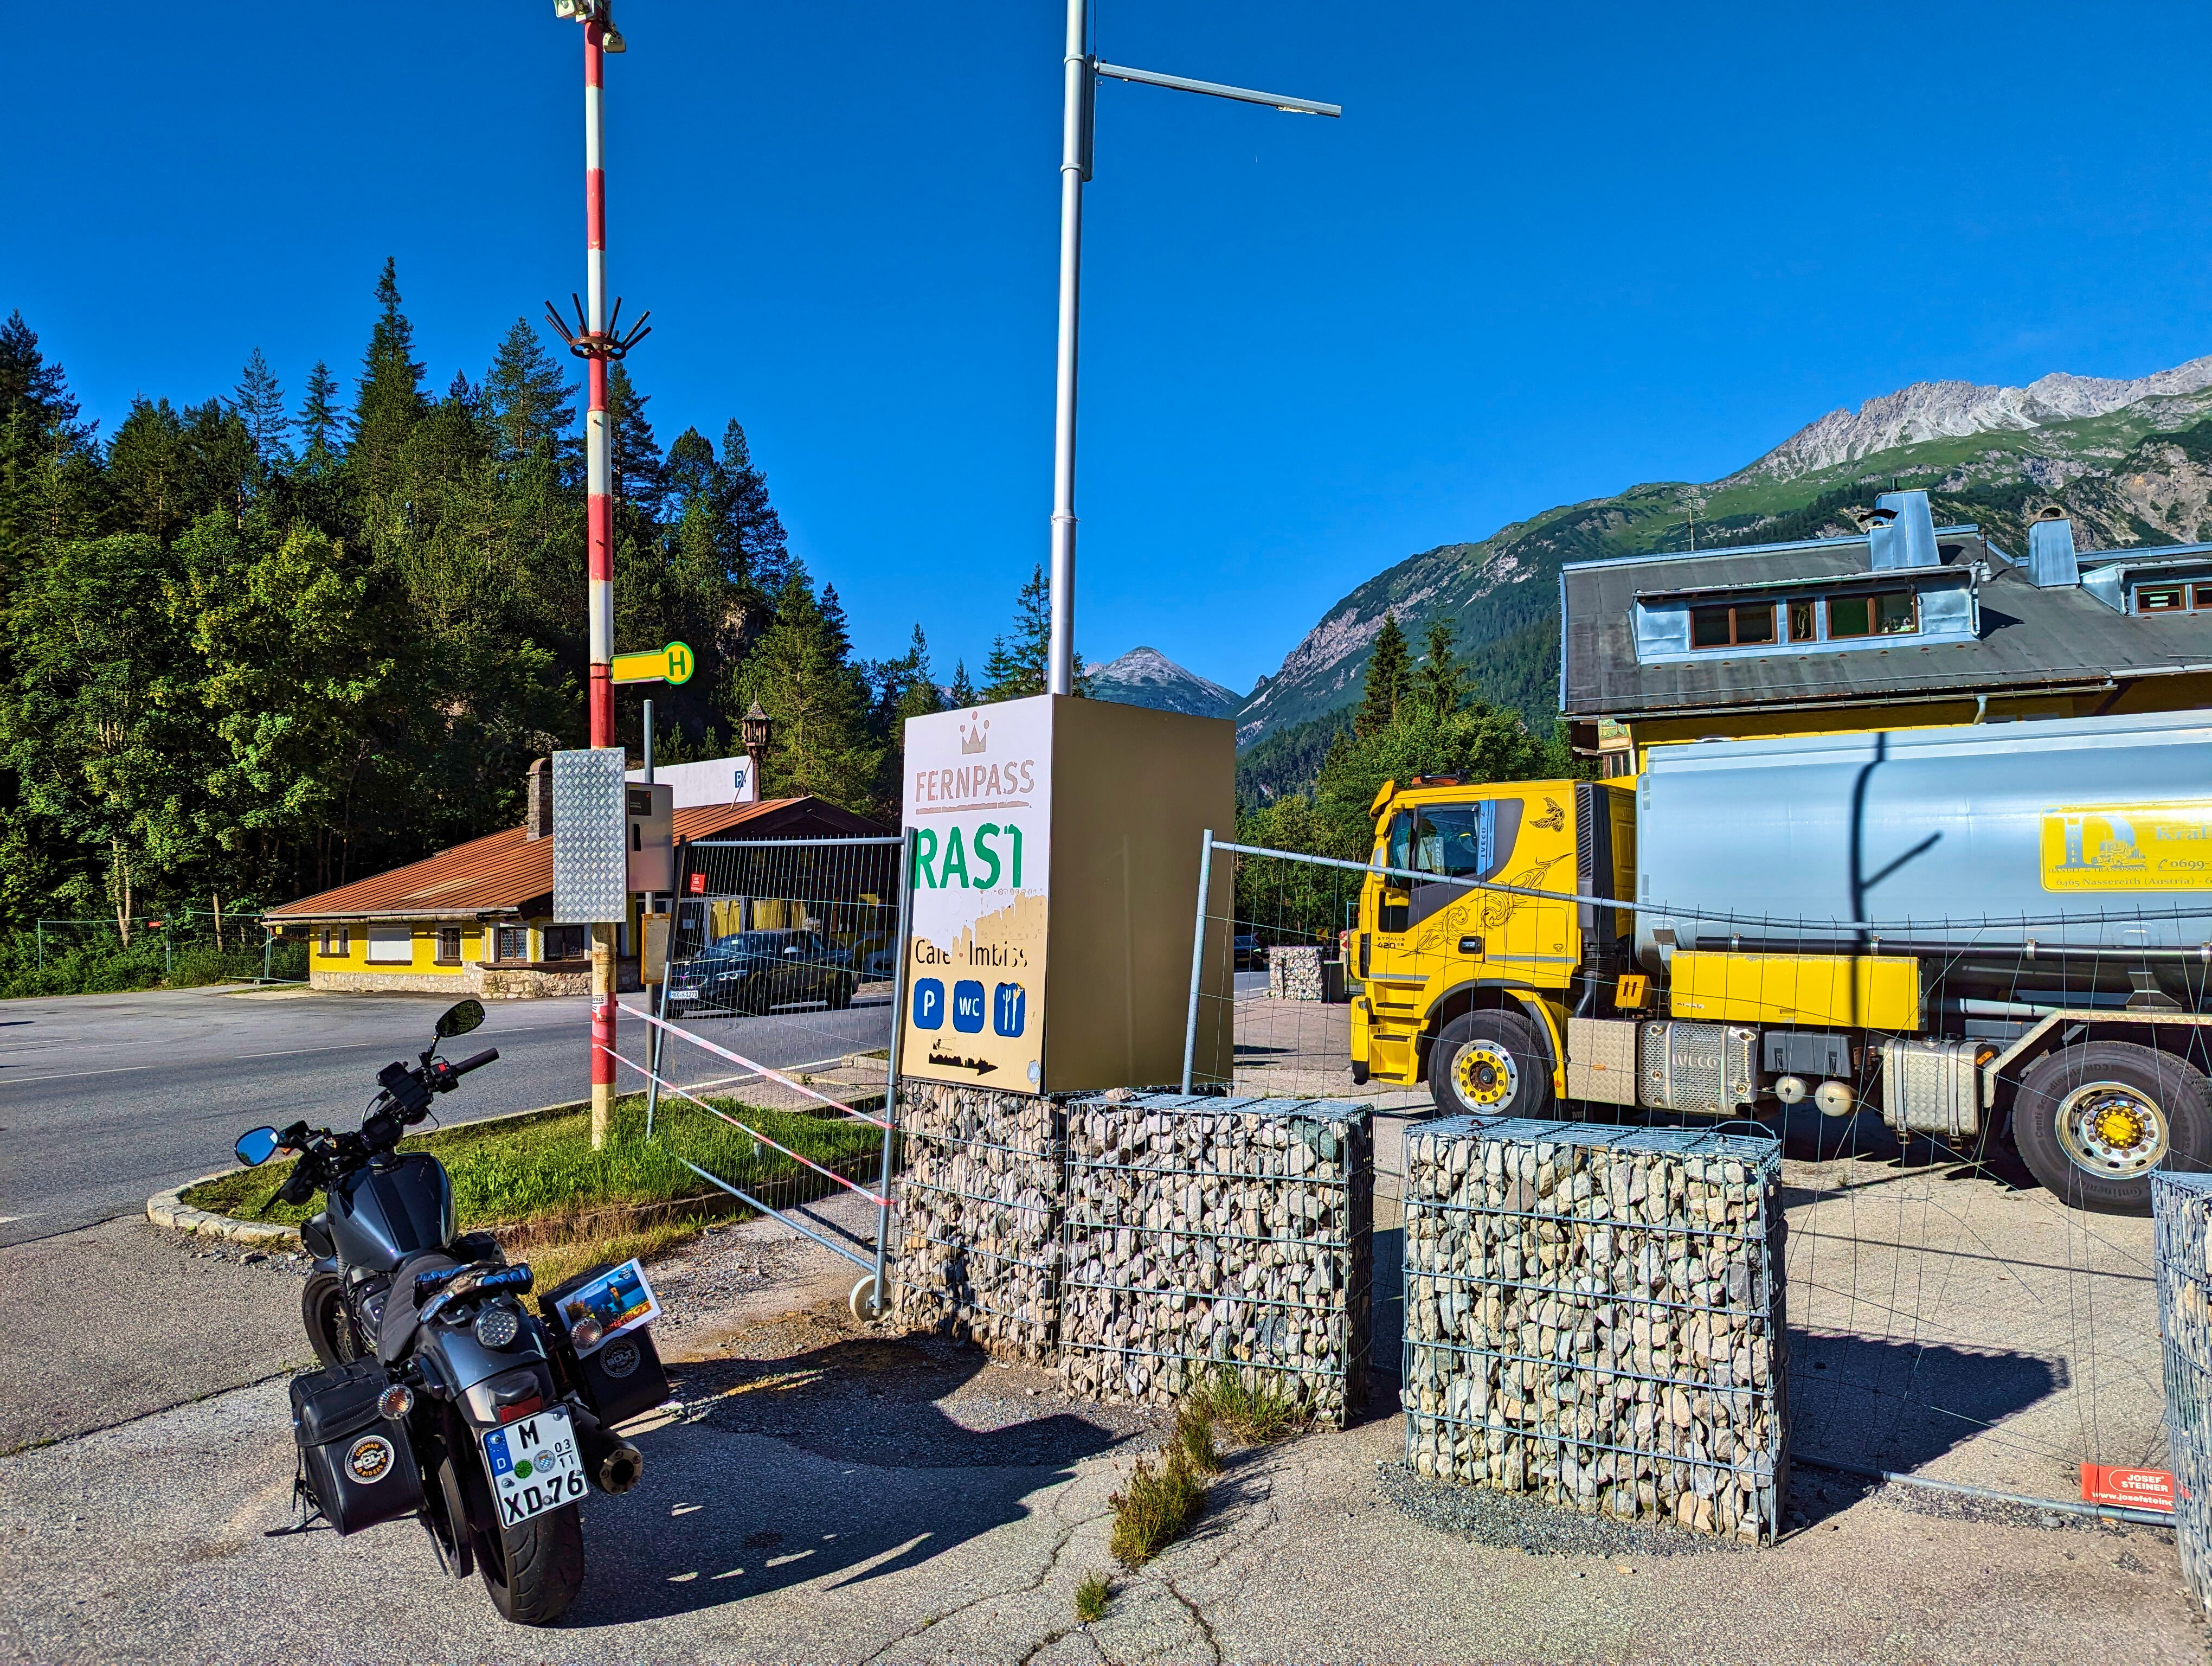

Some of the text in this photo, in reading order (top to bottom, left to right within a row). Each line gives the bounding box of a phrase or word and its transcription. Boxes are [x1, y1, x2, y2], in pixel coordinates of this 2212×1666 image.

[668, 651, 685, 676] H
[736, 773, 742, 786] P
[916, 760, 1034, 802] FERNPASS
[2170, 858, 2212, 870] 0699-
[2056, 879, 2080, 887] 6465
[2083, 877, 2140, 885] Nassereith
[2144, 877, 2195, 886] (Austria)
[923, 990, 935, 1017] P
[959, 996, 980, 1017] WC
[1673, 1054, 1720, 1068] IVECO
[518, 1420, 540, 1449] M
[355, 1443, 380, 1457] GERMAN
[554, 1439, 571, 1453] 03
[353, 1450, 386, 1469] BOLT
[496, 1457, 506, 1470] D
[558, 1454, 574, 1468] 11
[361, 1465, 383, 1477] RIDERS
[2127, 1474, 2162, 1483] JOSEF
[2121, 1481, 2169, 1492] STEINER
[503, 1470, 583, 1523] XD 76
